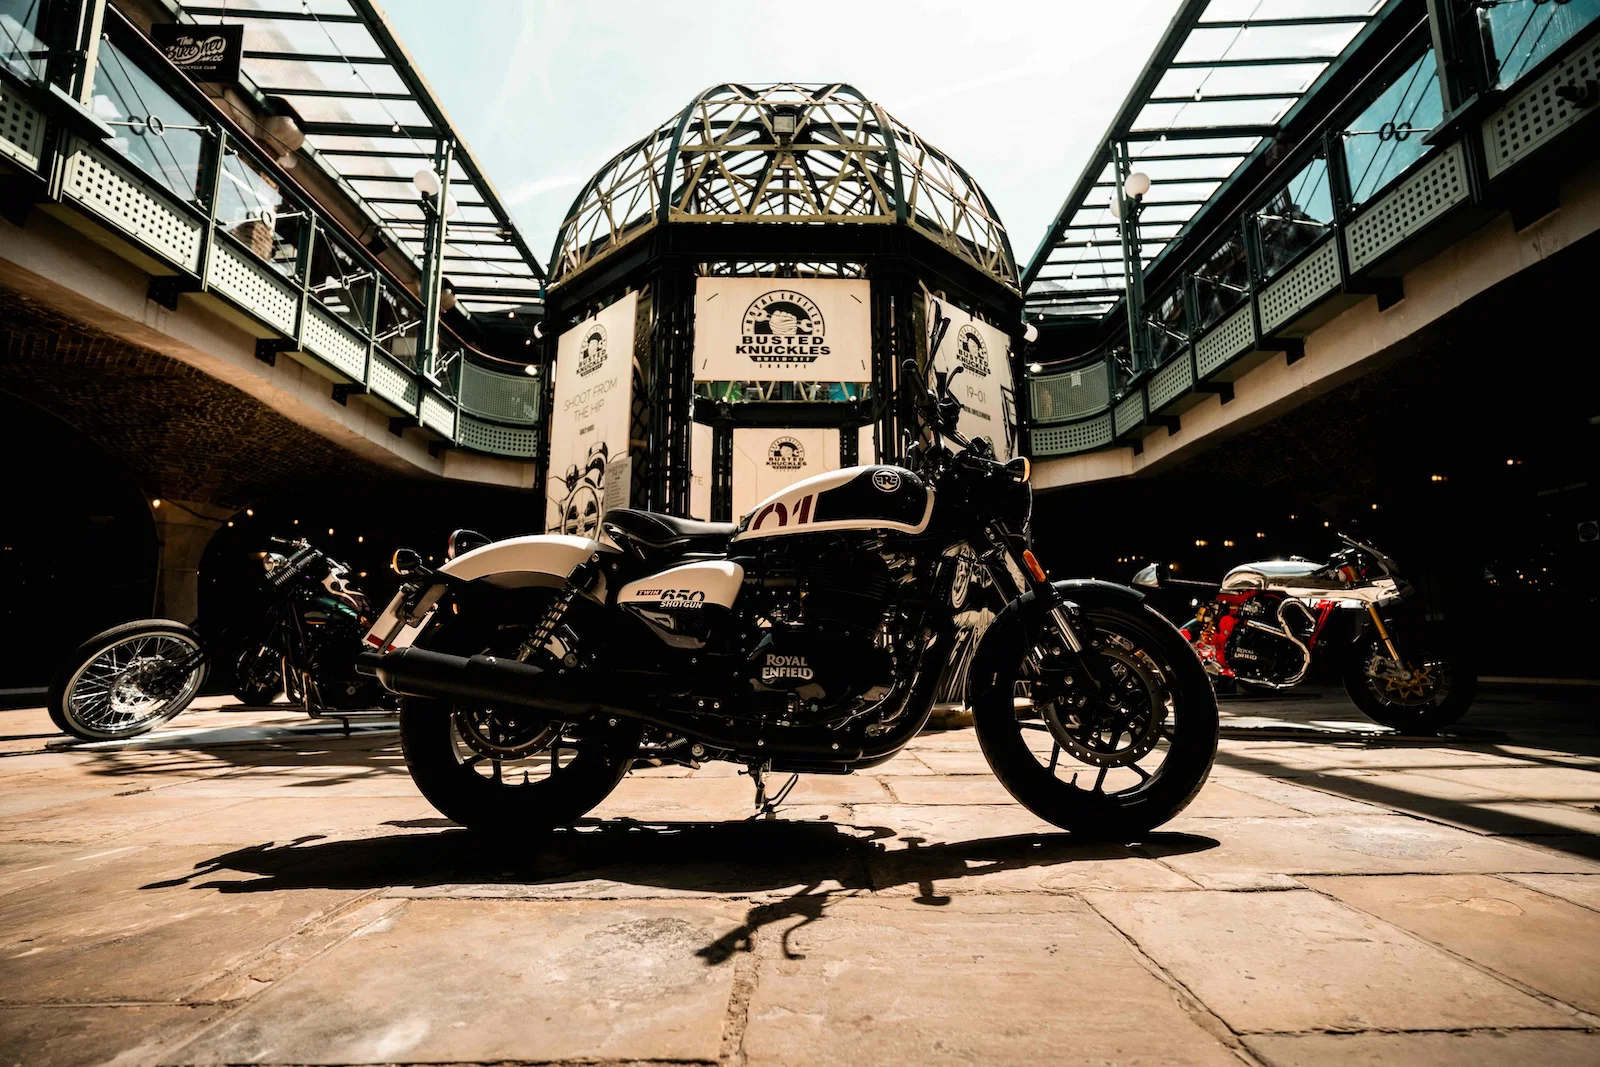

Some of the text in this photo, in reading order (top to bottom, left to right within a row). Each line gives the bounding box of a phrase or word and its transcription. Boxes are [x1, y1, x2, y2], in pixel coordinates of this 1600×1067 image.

[176, 35, 194, 45] The
[745, 293, 822, 326] ROYAL ENFIELD
[742, 335, 824, 345] BUSTED
[578, 349, 607, 368] BUSTED
[735, 345, 831, 355] KNUCKLES
[958, 348, 989, 368] BUSTED
[576, 353, 608, 375] KNUCKLES
[956, 353, 991, 375] KNUCKLES
[563, 376, 618, 412] SHOOT FROM
[965, 385, 987, 404] 19-01
[573, 399, 606, 424] THE HIP
[660, 589, 705, 602] 650
[660, 600, 703, 609] SHOTGUN
[766, 653, 808, 667] ROYAL
[762, 667, 814, 680] ENFIELD
